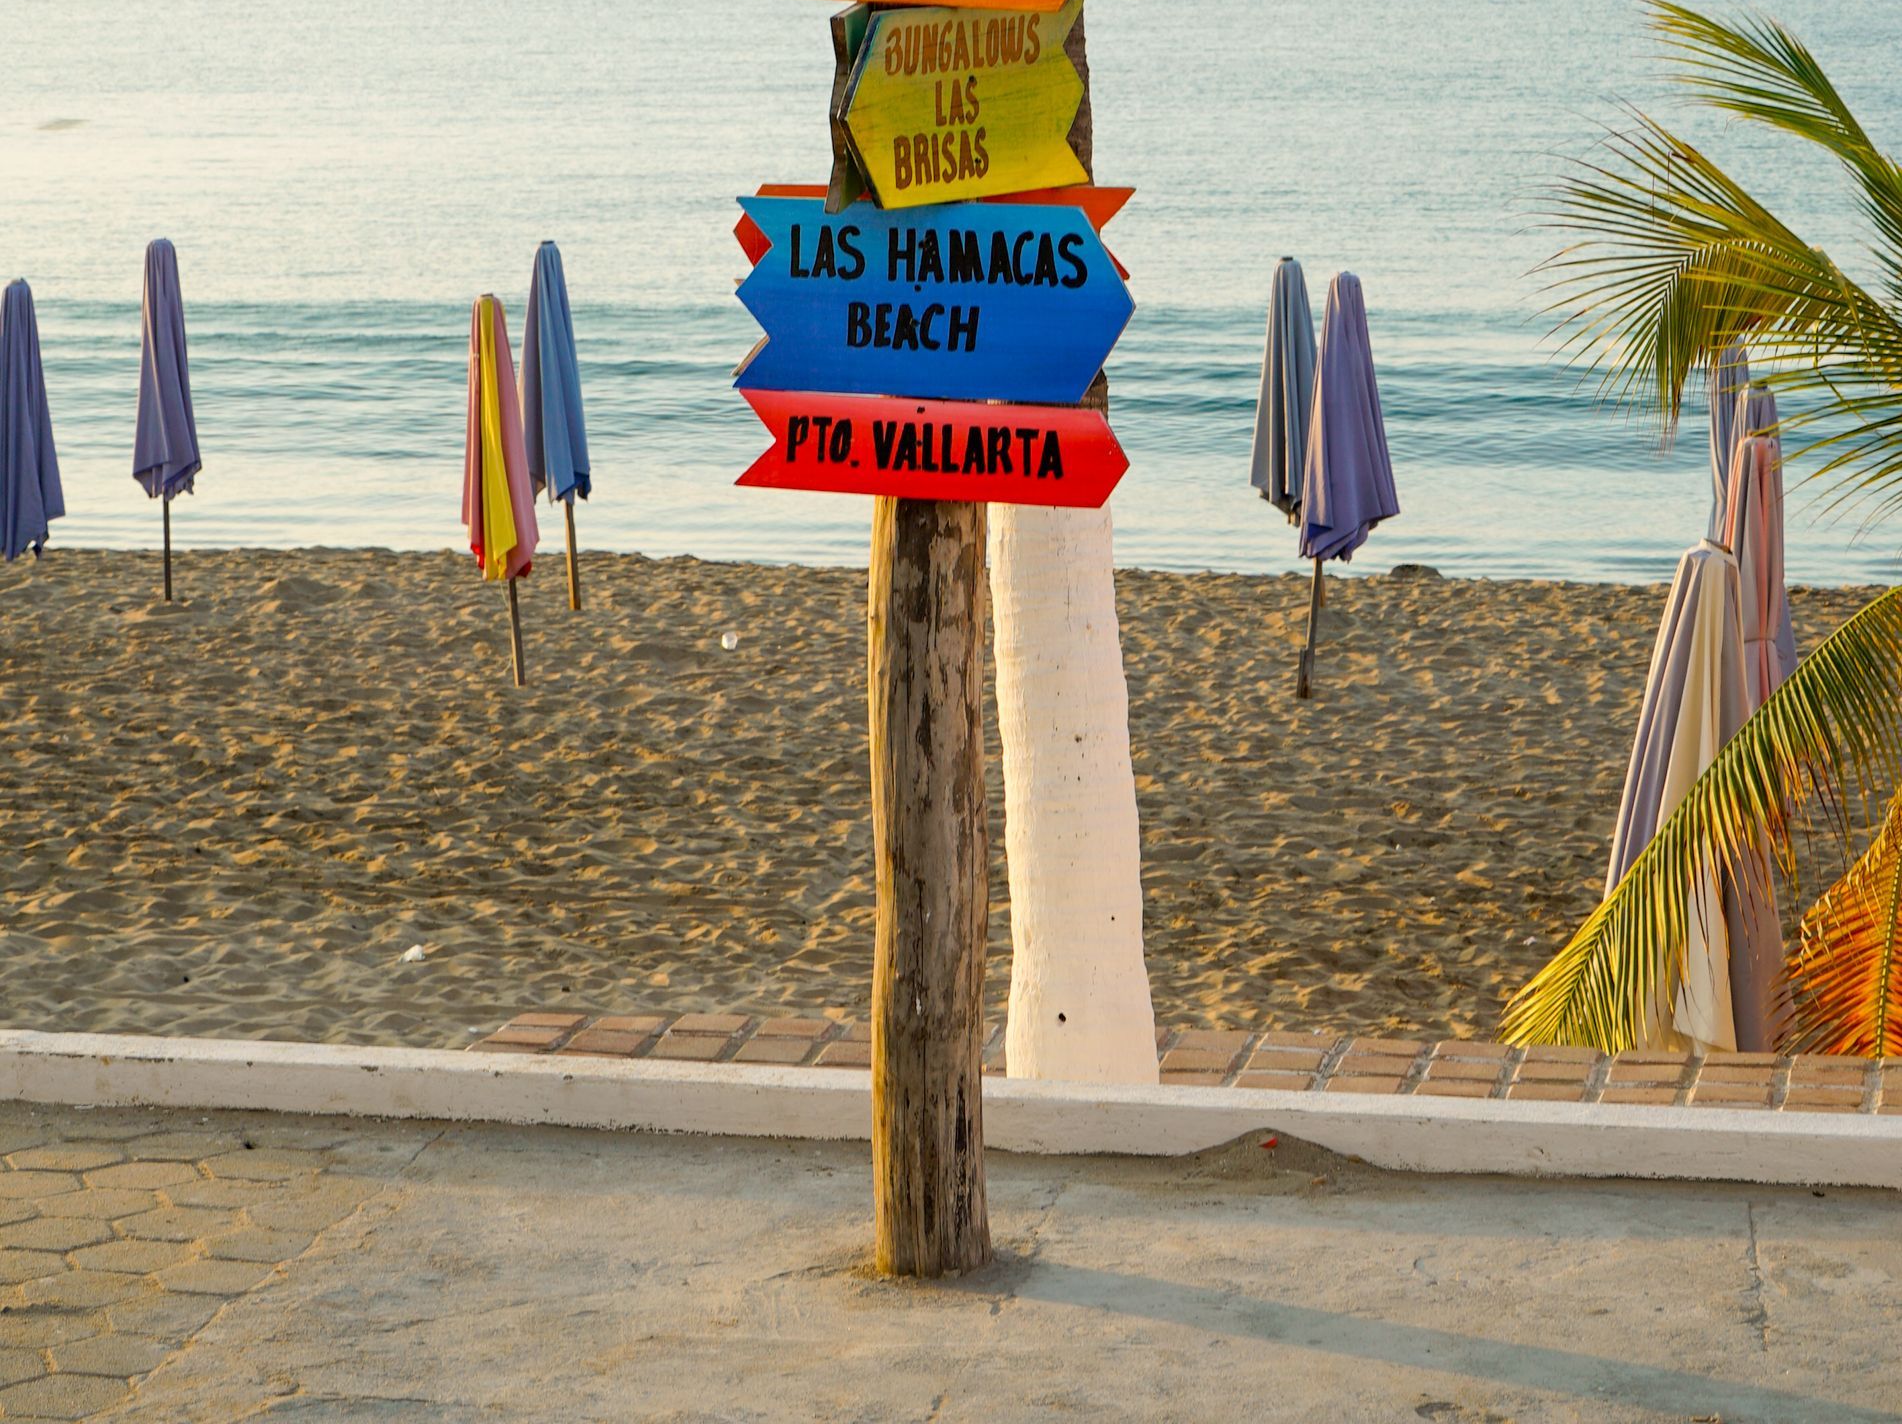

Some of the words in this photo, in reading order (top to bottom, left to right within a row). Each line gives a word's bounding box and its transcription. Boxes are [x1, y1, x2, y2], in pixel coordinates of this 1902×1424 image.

[885, 12, 1041, 75] BUNGALOWS
[935, 77, 980, 126] LAS
[893, 129, 990, 191] BRISAS
[789, 224, 866, 280] LAS
[887, 226, 1089, 289] HAMACAS
[846, 301, 980, 352] BEACH
[786, 415, 858, 469] PTO.
[872, 419, 1064, 480] VALLARTA
